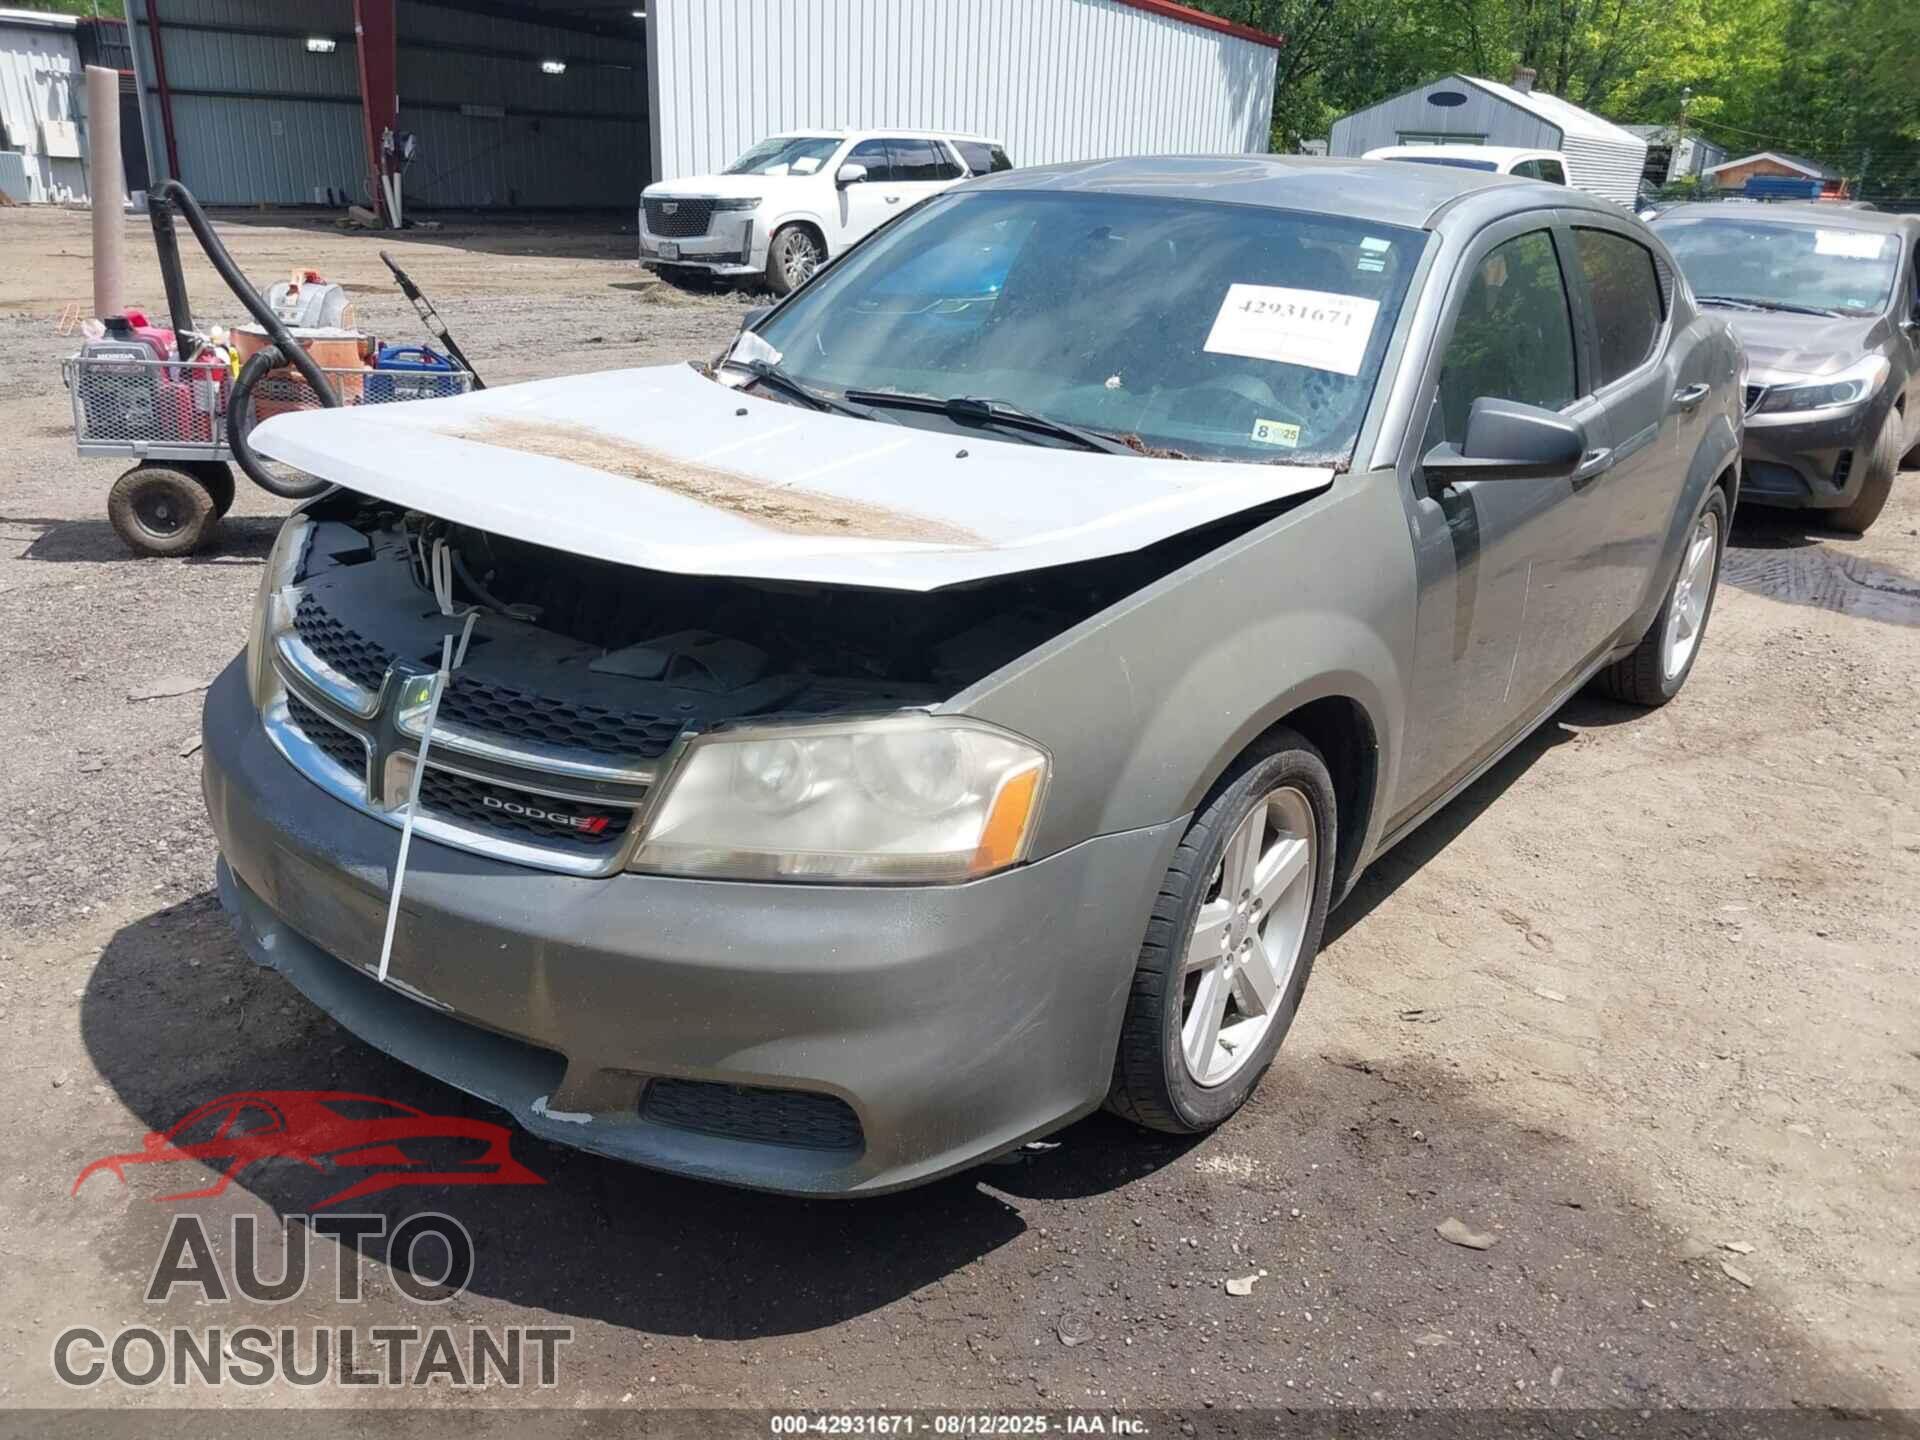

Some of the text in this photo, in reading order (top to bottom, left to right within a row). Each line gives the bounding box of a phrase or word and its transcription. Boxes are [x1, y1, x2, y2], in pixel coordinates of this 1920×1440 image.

[1238, 299, 1353, 327] 42931671
[1257, 424, 1269, 438] 8
[483, 796, 591, 828] DODGE
